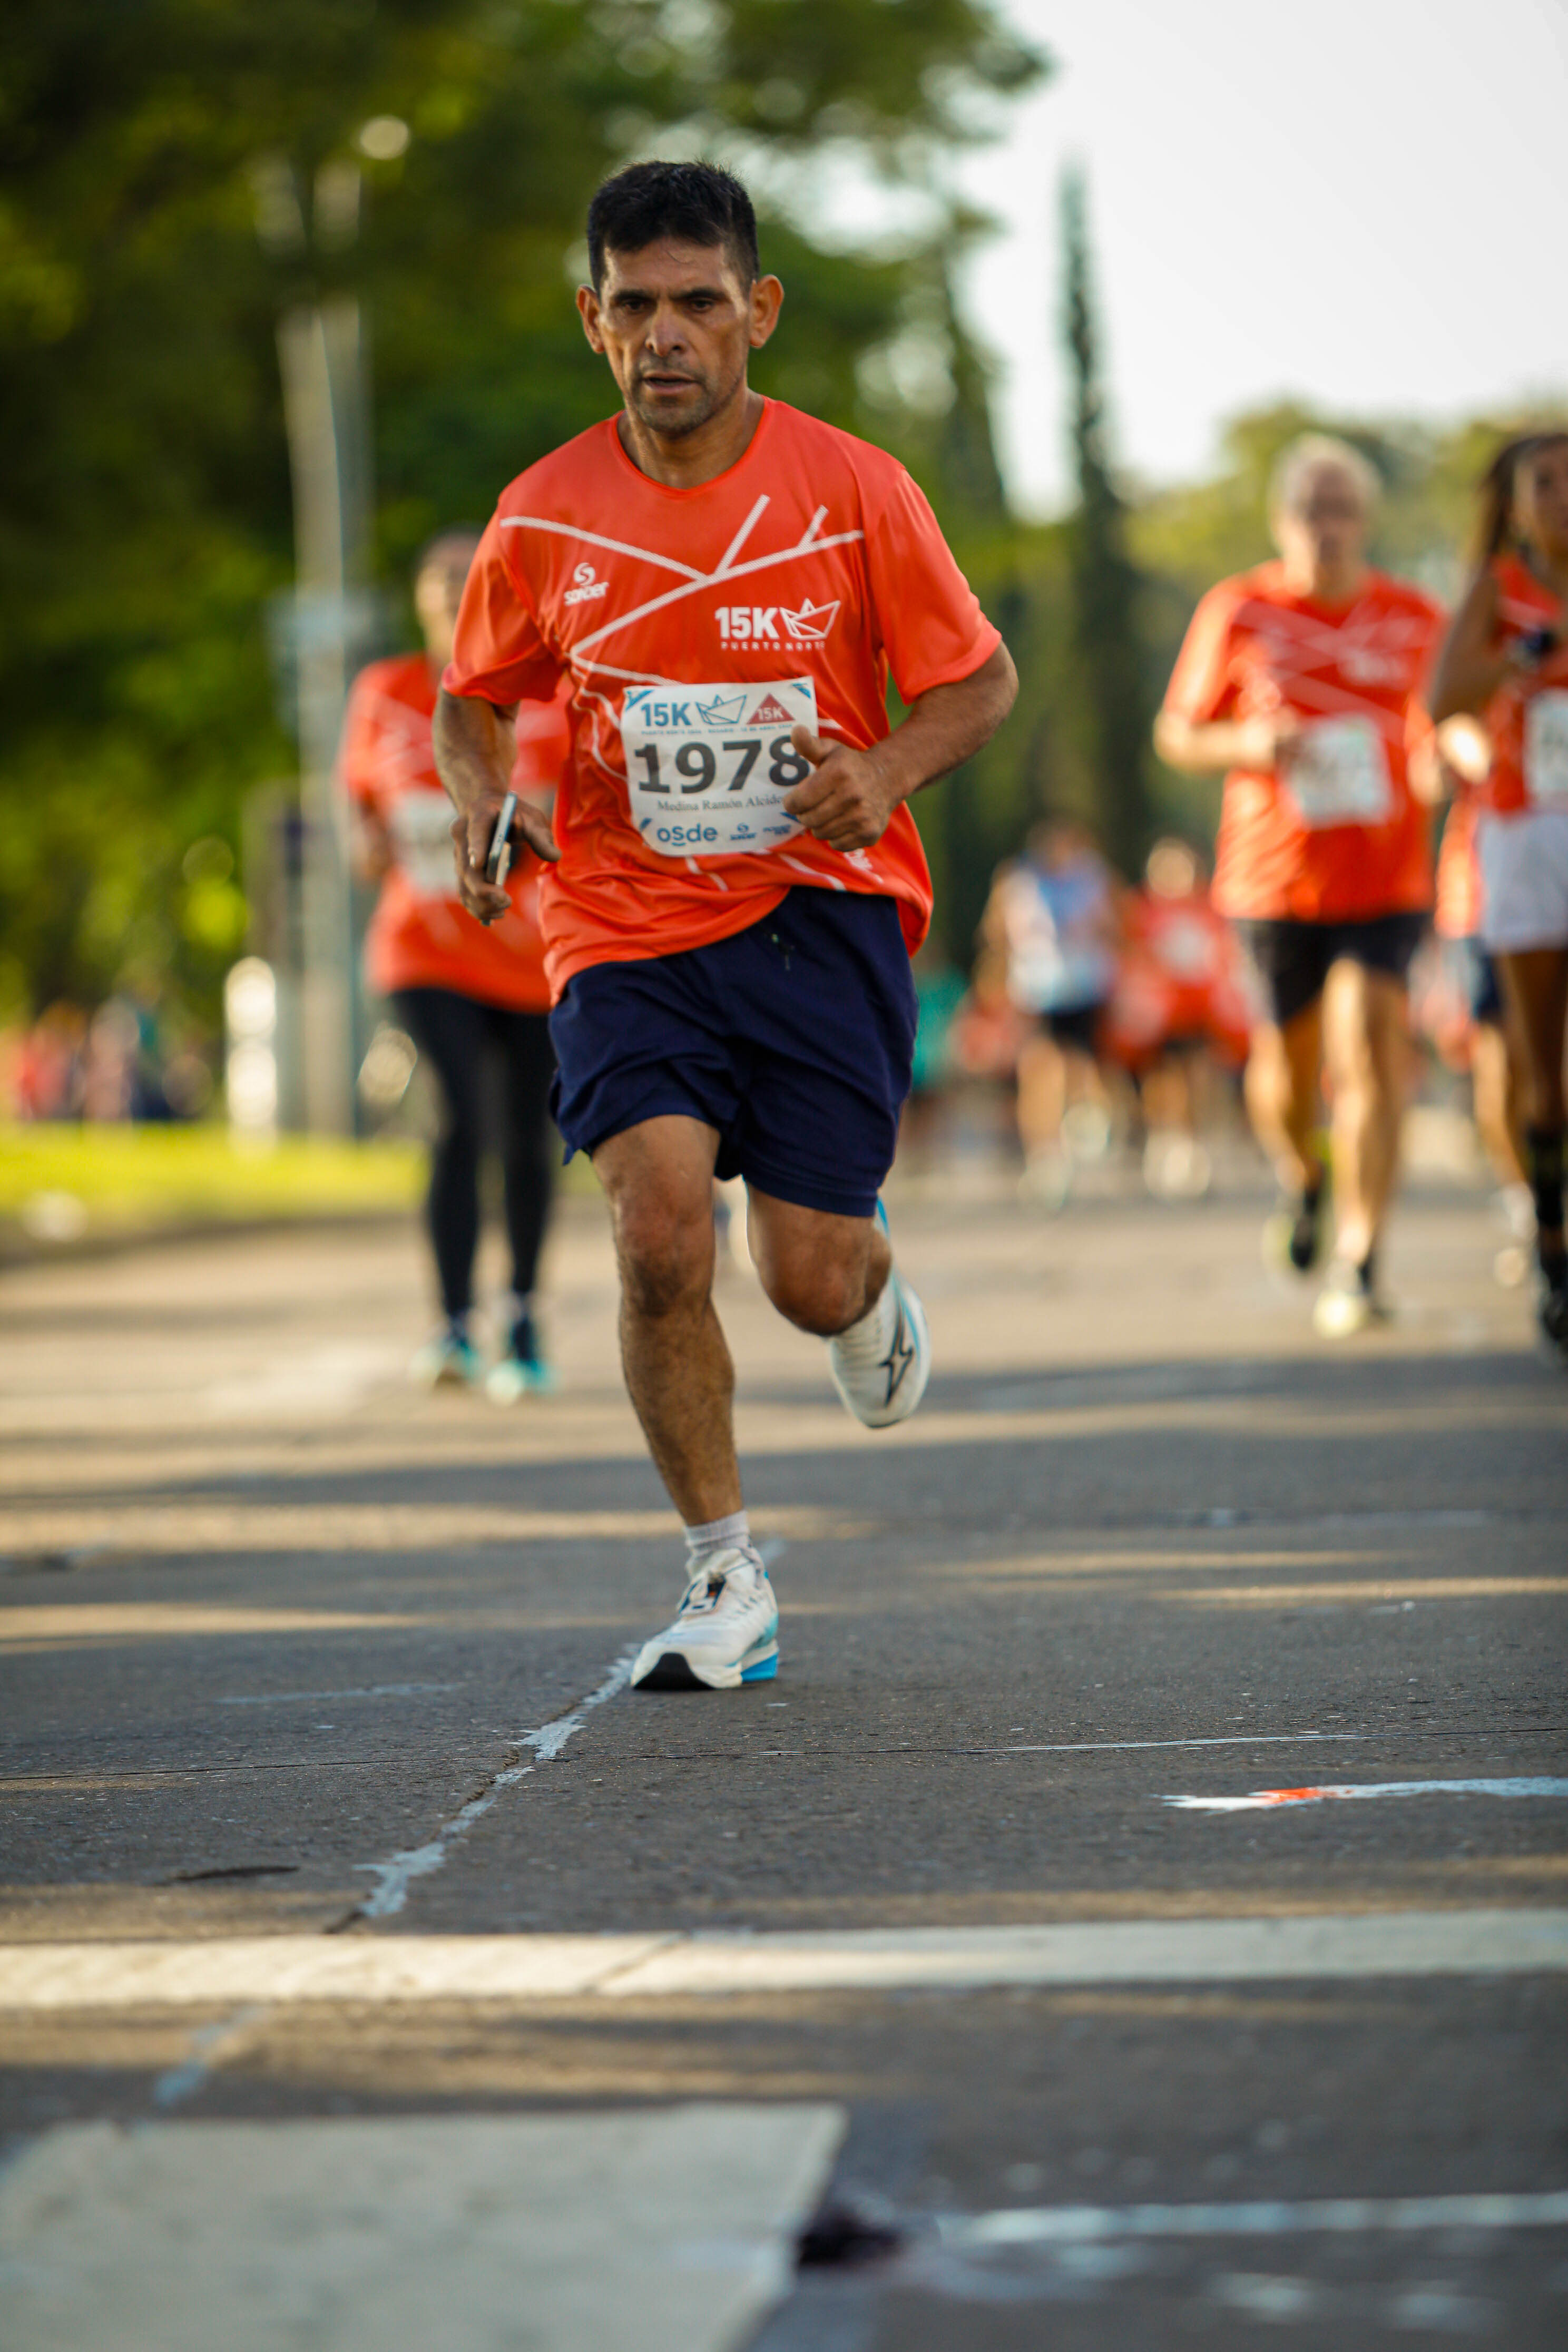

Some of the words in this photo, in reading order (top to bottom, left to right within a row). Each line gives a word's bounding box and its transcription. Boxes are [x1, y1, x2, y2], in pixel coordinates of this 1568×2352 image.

[714, 606, 780, 639] 15K
[720, 641, 781, 651] PUERTO
[786, 641, 826, 651] NORTE
[640, 702, 692, 727] 15K
[756, 707, 784, 722] 15K
[634, 734, 810, 794] 1978
[657, 800, 699, 811] Medina
[656, 822, 718, 842] osde
